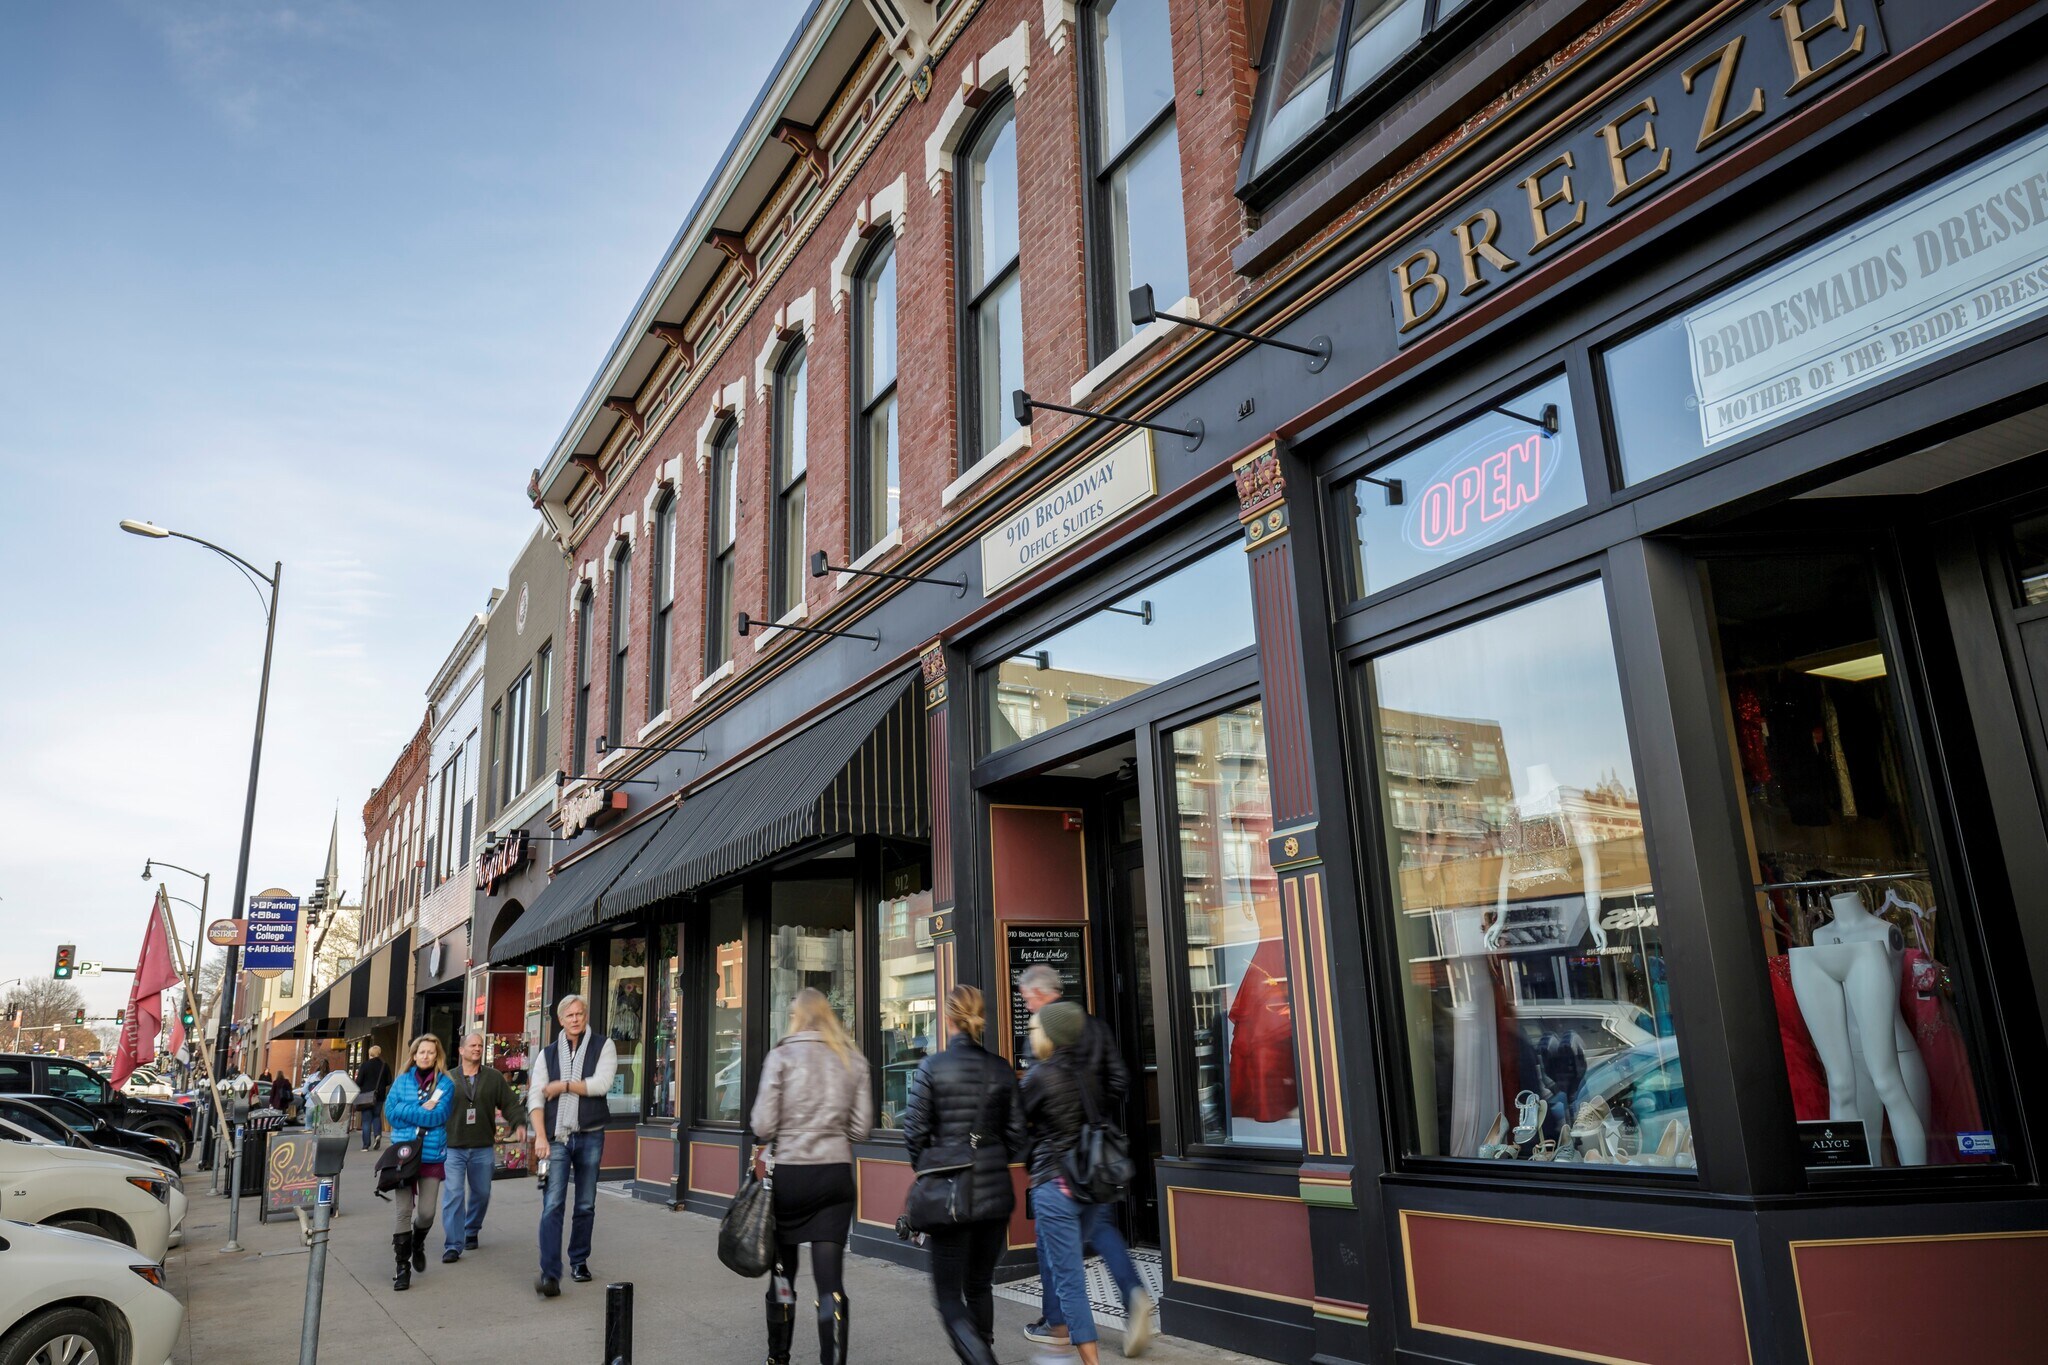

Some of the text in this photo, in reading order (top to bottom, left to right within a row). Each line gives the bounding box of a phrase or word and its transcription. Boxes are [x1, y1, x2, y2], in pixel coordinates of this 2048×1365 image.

[1391, 0, 1866, 334] BREEZE
[1699, 171, 2048, 378] BRIDESMAIDS DRESSE
[1717, 376, 1803, 427] MOTHER
[1808, 360, 1836, 390] OF
[1841, 340, 1887, 376] THE
[1889, 304, 1968, 356] BRIDE
[1421, 434, 1540, 546] OPEN
[1006, 460, 1115, 547] 910 BROADWAY
[1019, 499, 1104, 564] OFFICE SUITES
[895, 874, 909, 893] 912
[265, 911, 280, 919] Bus
[266, 902, 296, 911] Parking
[209, 929, 239, 938] DISTRICT
[255, 932, 284, 941] College
[256, 924, 293, 932] Columbia
[254, 945, 295, 953] Arts District
